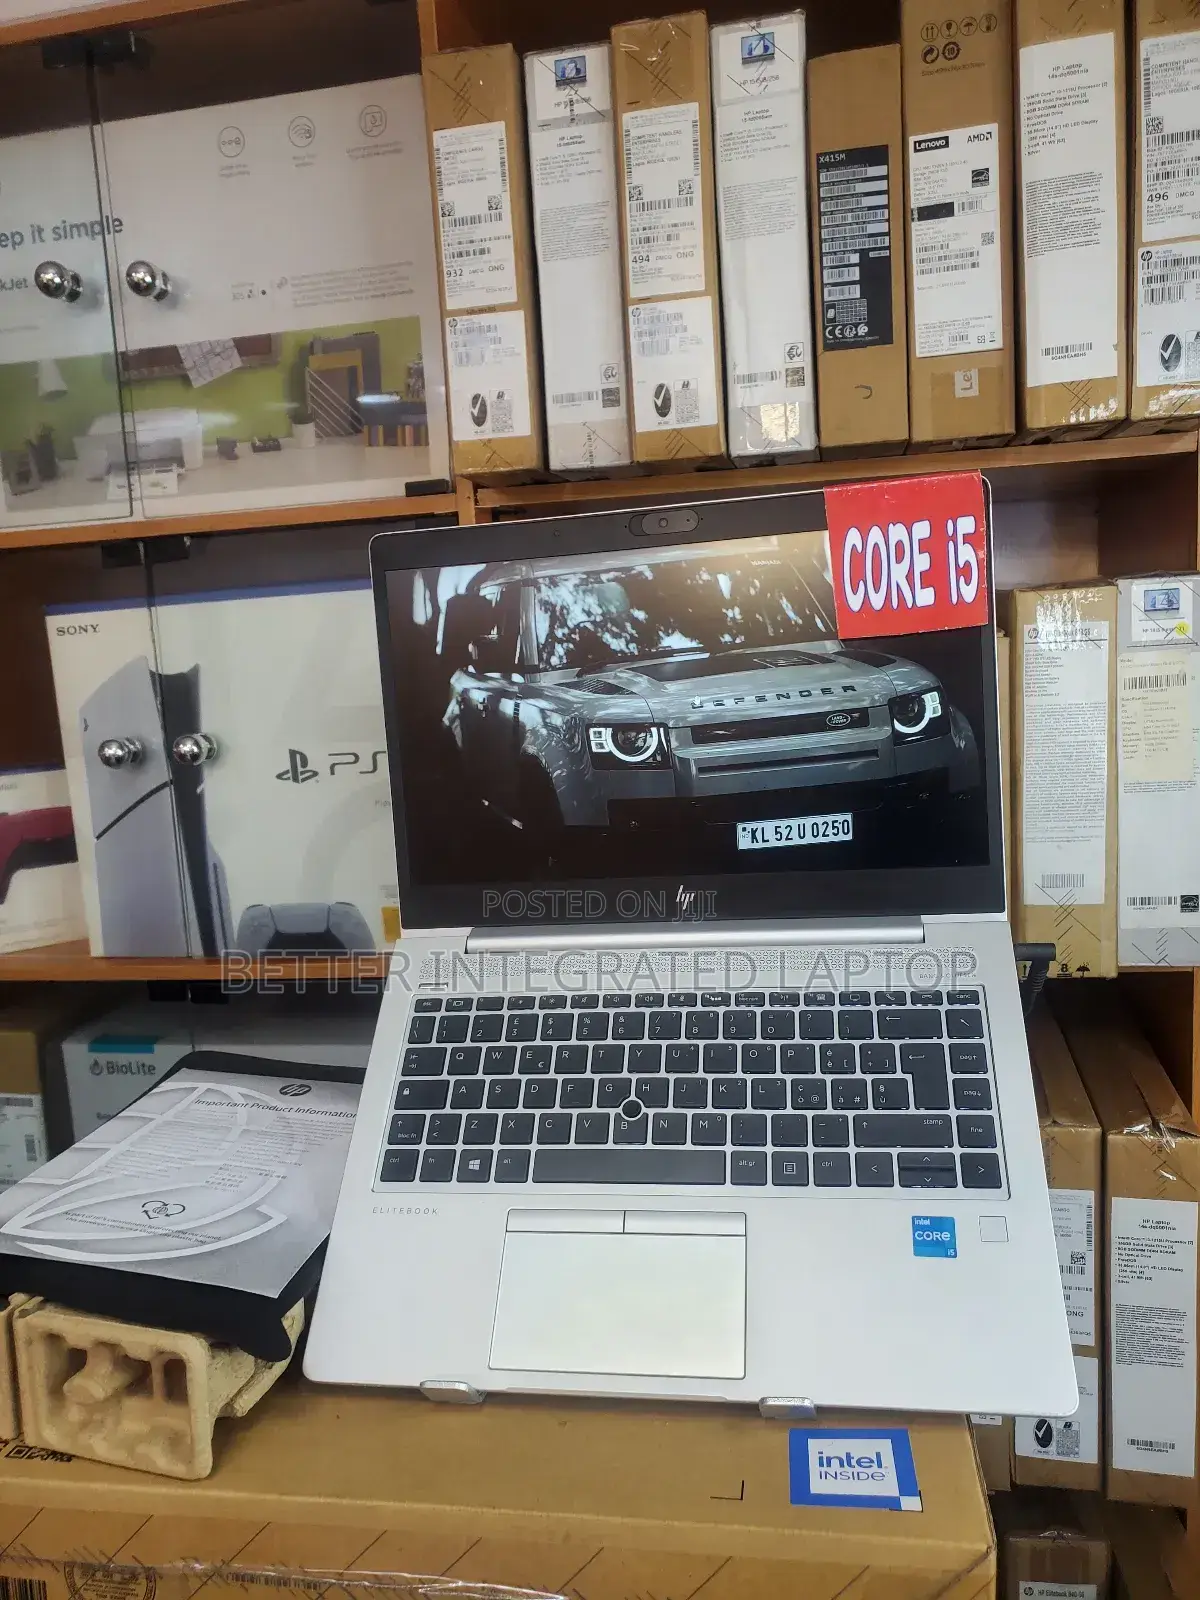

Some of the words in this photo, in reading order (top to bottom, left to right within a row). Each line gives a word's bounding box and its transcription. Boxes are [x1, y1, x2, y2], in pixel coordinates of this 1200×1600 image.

[916, 139, 946, 150] Lenovo
[966, 133, 985, 144] AMD
[818, 153, 846, 164] X415M
[1147, 191, 1169, 203] 496
[30, 223, 45, 245] it
[52, 214, 124, 242] simple
[631, 254, 650, 264] 494
[446, 268, 464, 278] 932
[843, 519, 936, 613] CORE
[946, 514, 980, 606] i5
[56, 623, 100, 637] SONY
[751, 826, 769, 844] KL
[775, 824, 794, 842] 52
[797, 823, 806, 840] U
[811, 819, 850, 839] 0250
[106, 1060, 156, 1076] BioLite
[194, 1098, 249, 1110] Important
[250, 1102, 292, 1113] Product
[372, 1206, 440, 1216] ELITEBOOK
[914, 1218, 930, 1226] intel
[1066, 1310, 1084, 1318] ONG
[817, 1450, 884, 1471] intel
[818, 1470, 886, 1483] INSIDE
